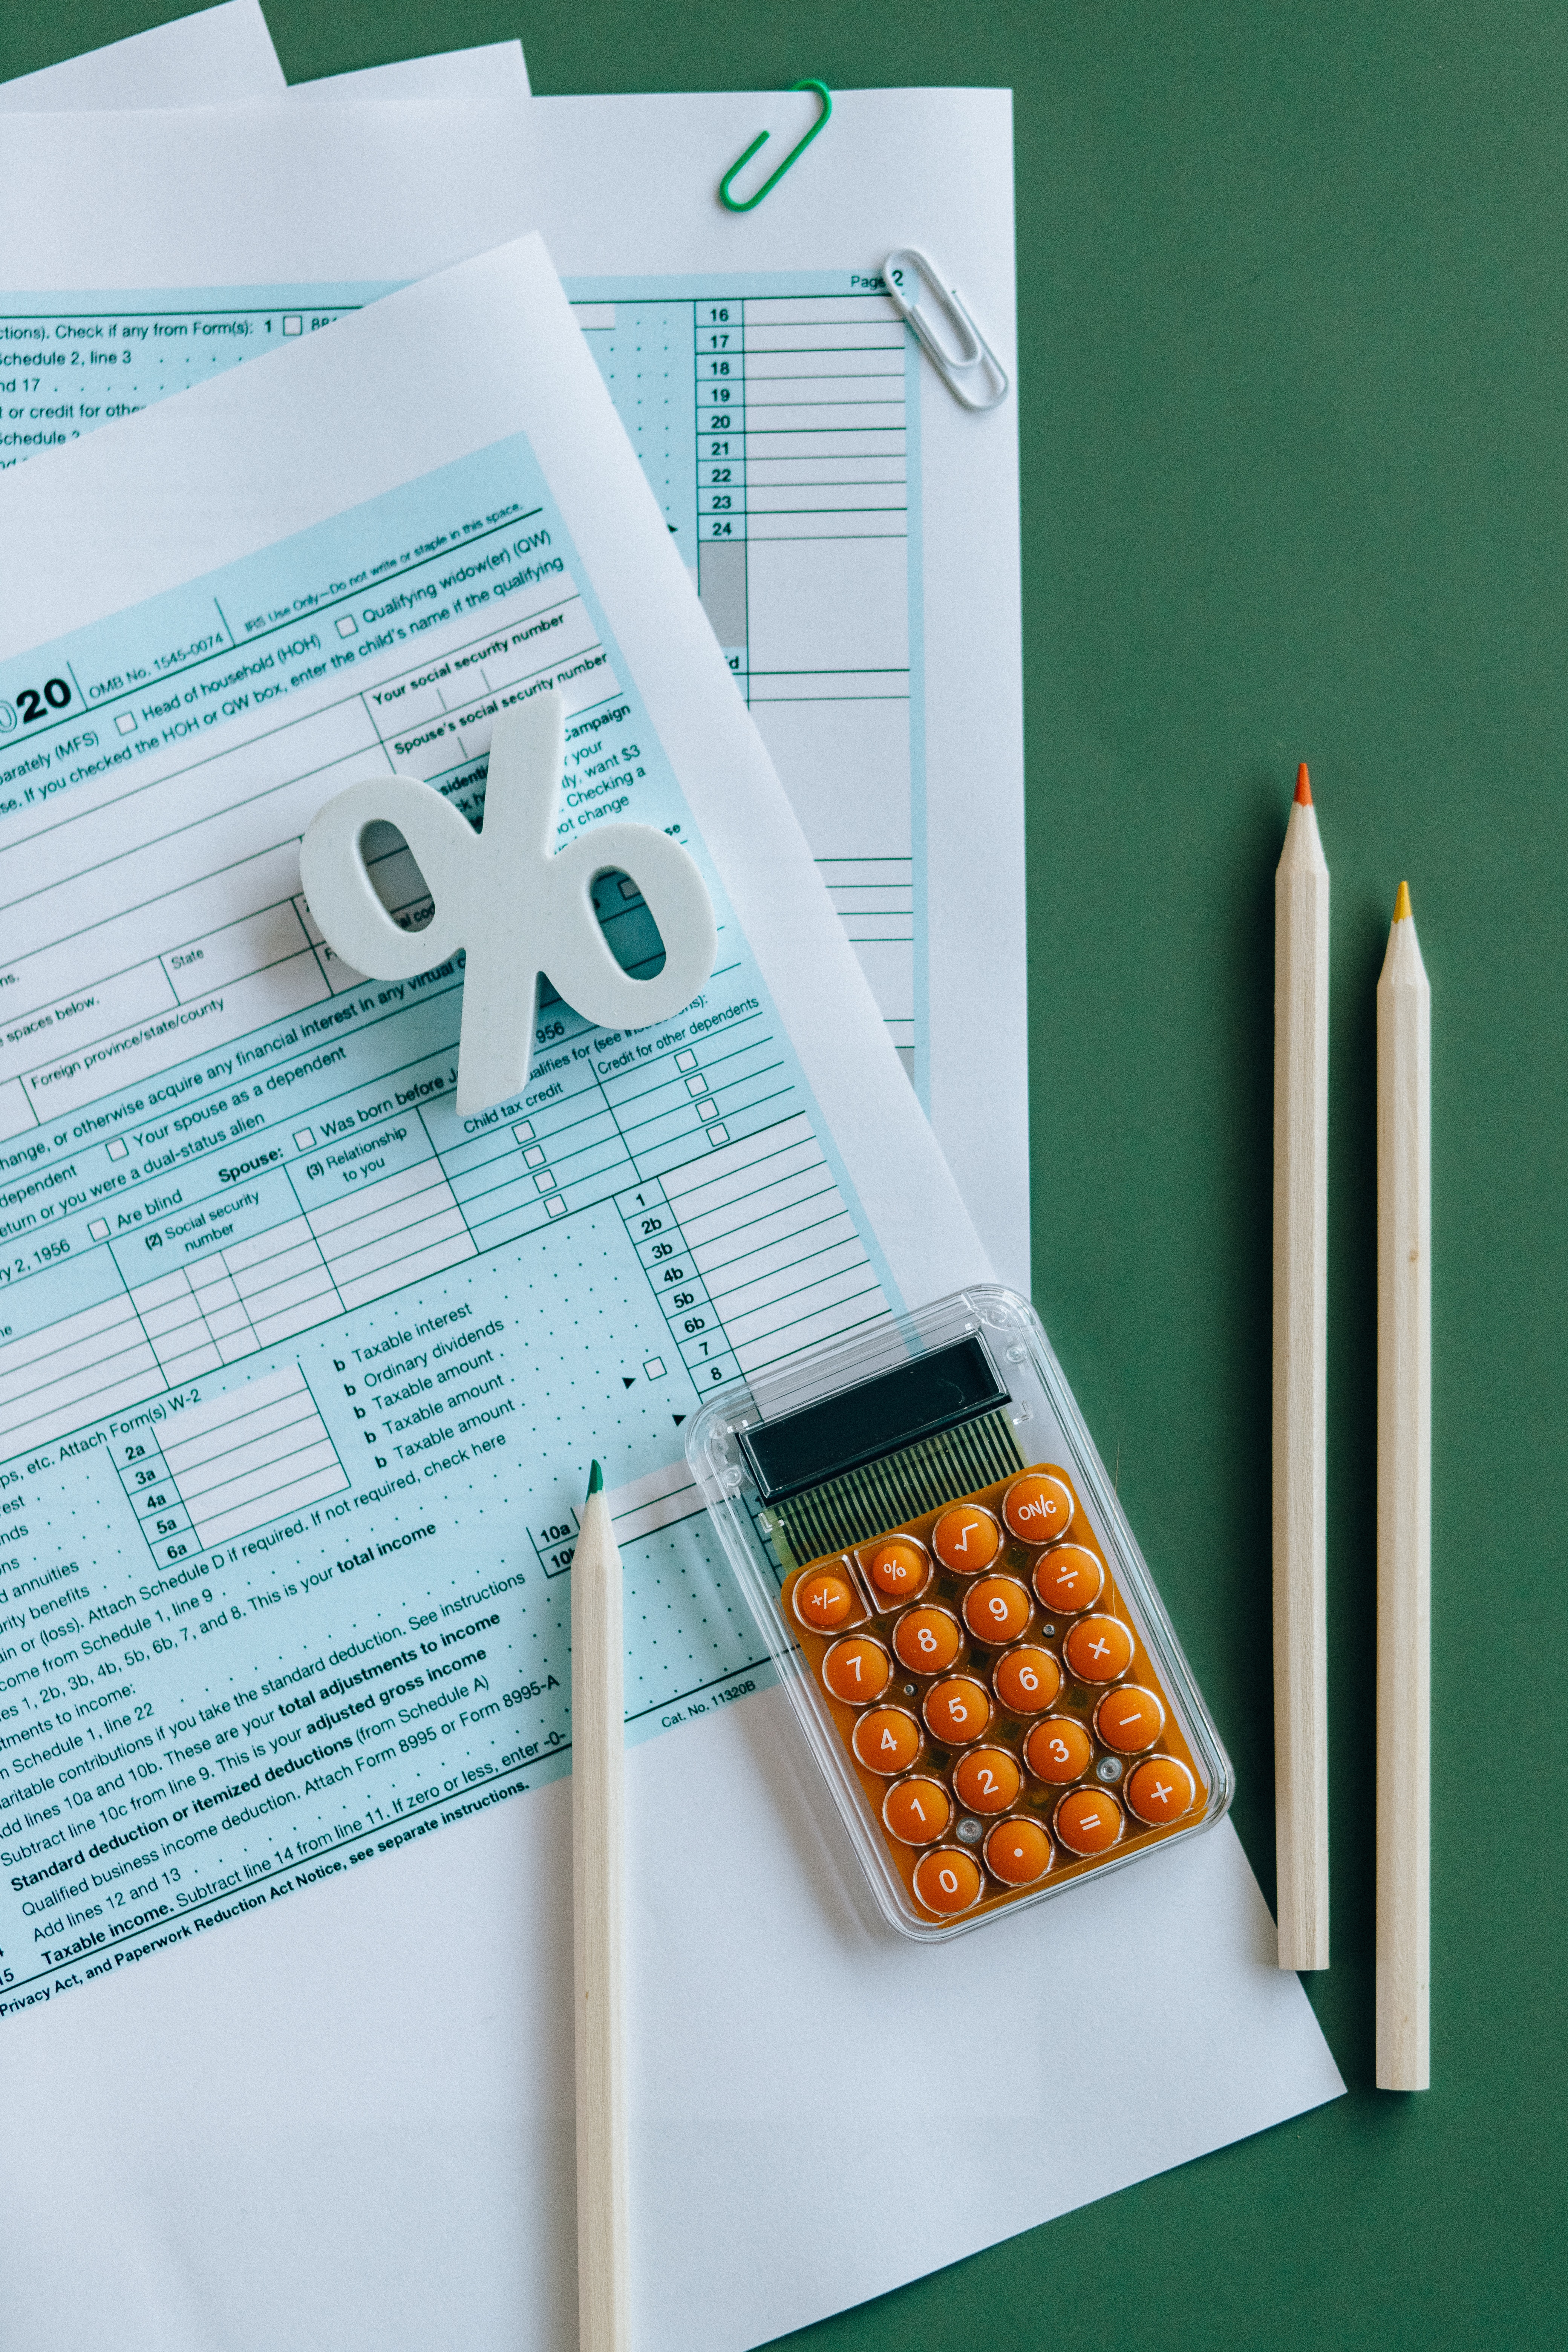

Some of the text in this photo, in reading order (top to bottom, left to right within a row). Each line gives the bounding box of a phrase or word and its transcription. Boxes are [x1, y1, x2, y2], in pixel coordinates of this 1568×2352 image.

[851, 269, 903, 291] Page 2
[710, 308, 729, 323] 16
[55, 319, 272, 341] Check if any from Form(s): 1
[710, 334, 730, 349] 17
[70, 350, 132, 367] 2, line 3
[710, 361, 730, 376] 18
[711, 387, 731, 403] 19
[8, 403, 101, 420] or credit for
[711, 415, 731, 429] 20
[711, 441, 729, 456] 21
[711, 468, 732, 483] 22
[712, 495, 732, 510] 23
[712, 521, 732, 536] 24
[349, 571, 367, 586] not
[400, 552, 410, 562] or
[414, 536, 447, 557] staple
[449, 530, 461, 540] in
[462, 520, 483, 534] this
[362, 529, 551, 623] Qualifying widow(er) (QW)
[89, 632, 224, 698] OMB No. 1545-0074
[372, 614, 564, 706] Your social security number
[141, 634, 321, 721] Head of household (HOH)
[394, 653, 607, 755] Spouse's social security number
[55, 731, 99, 760] (MFS)
[584, 744, 641, 778] want $3
[567, 767, 646, 807] Checking a
[577, 796, 629, 825] change
[171, 949, 204, 969] State
[6, 997, 100, 1042] spaces below.
[31, 998, 224, 1090] Foreign province/state/county
[597, 998, 760, 1075] Credit for other dependents
[132, 1046, 347, 1147] Your spouse as a dependent
[463, 1082, 564, 1133] Child tax credit
[217, 1077, 445, 1183] Spouse: Was born before
[306, 1128, 407, 1181] (3) Relationship
[342, 1158, 385, 1182] to you
[118, 1188, 183, 1229] Are blind
[635, 1193, 646, 1207] 1
[144, 1191, 259, 1251] (2) Social security
[641, 1217, 662, 1235] 2b
[184, 1223, 234, 1253] number
[651, 1242, 673, 1259] 3b
[663, 1267, 684, 1283] 4b
[673, 1292, 695, 1309] 5b
[684, 1317, 705, 1334] 6b
[332, 1303, 473, 1373] b Taxable interest
[698, 1341, 709, 1356] 7
[343, 1320, 504, 1397] b Ordinary dividends
[710, 1366, 723, 1381] 8
[125, 1445, 146, 1461] 2a
[135, 1469, 156, 1485] 3a
[147, 1494, 167, 1508] 4a
[156, 1519, 178, 1534] 5a
[540, 1524, 572, 1543] 10a
[167, 1544, 188, 1559] 6a
[989, 1597, 1008, 1621] 9
[917, 1628, 937, 1652] 8
[846, 1656, 862, 1681] 7
[1019, 1667, 1038, 1690] 6
[661, 1680, 756, 1728] Cat. No. 11320B
[948, 1697, 968, 1722] 5
[881, 1728, 897, 1751] 4
[1049, 1739, 1069, 1762] 3
[977, 1769, 999, 1795] 2
[910, 1798, 926, 1821] 1
[40, 1731, 567, 1965] Taxable income. Subtract line 14 from line 11. If zero or less, enter -0-
[939, 1869, 958, 1893] 0
[0, 1782, 530, 2017] Privacy Act, and Paperwork Reduction Act Notice, see separate instructions.
